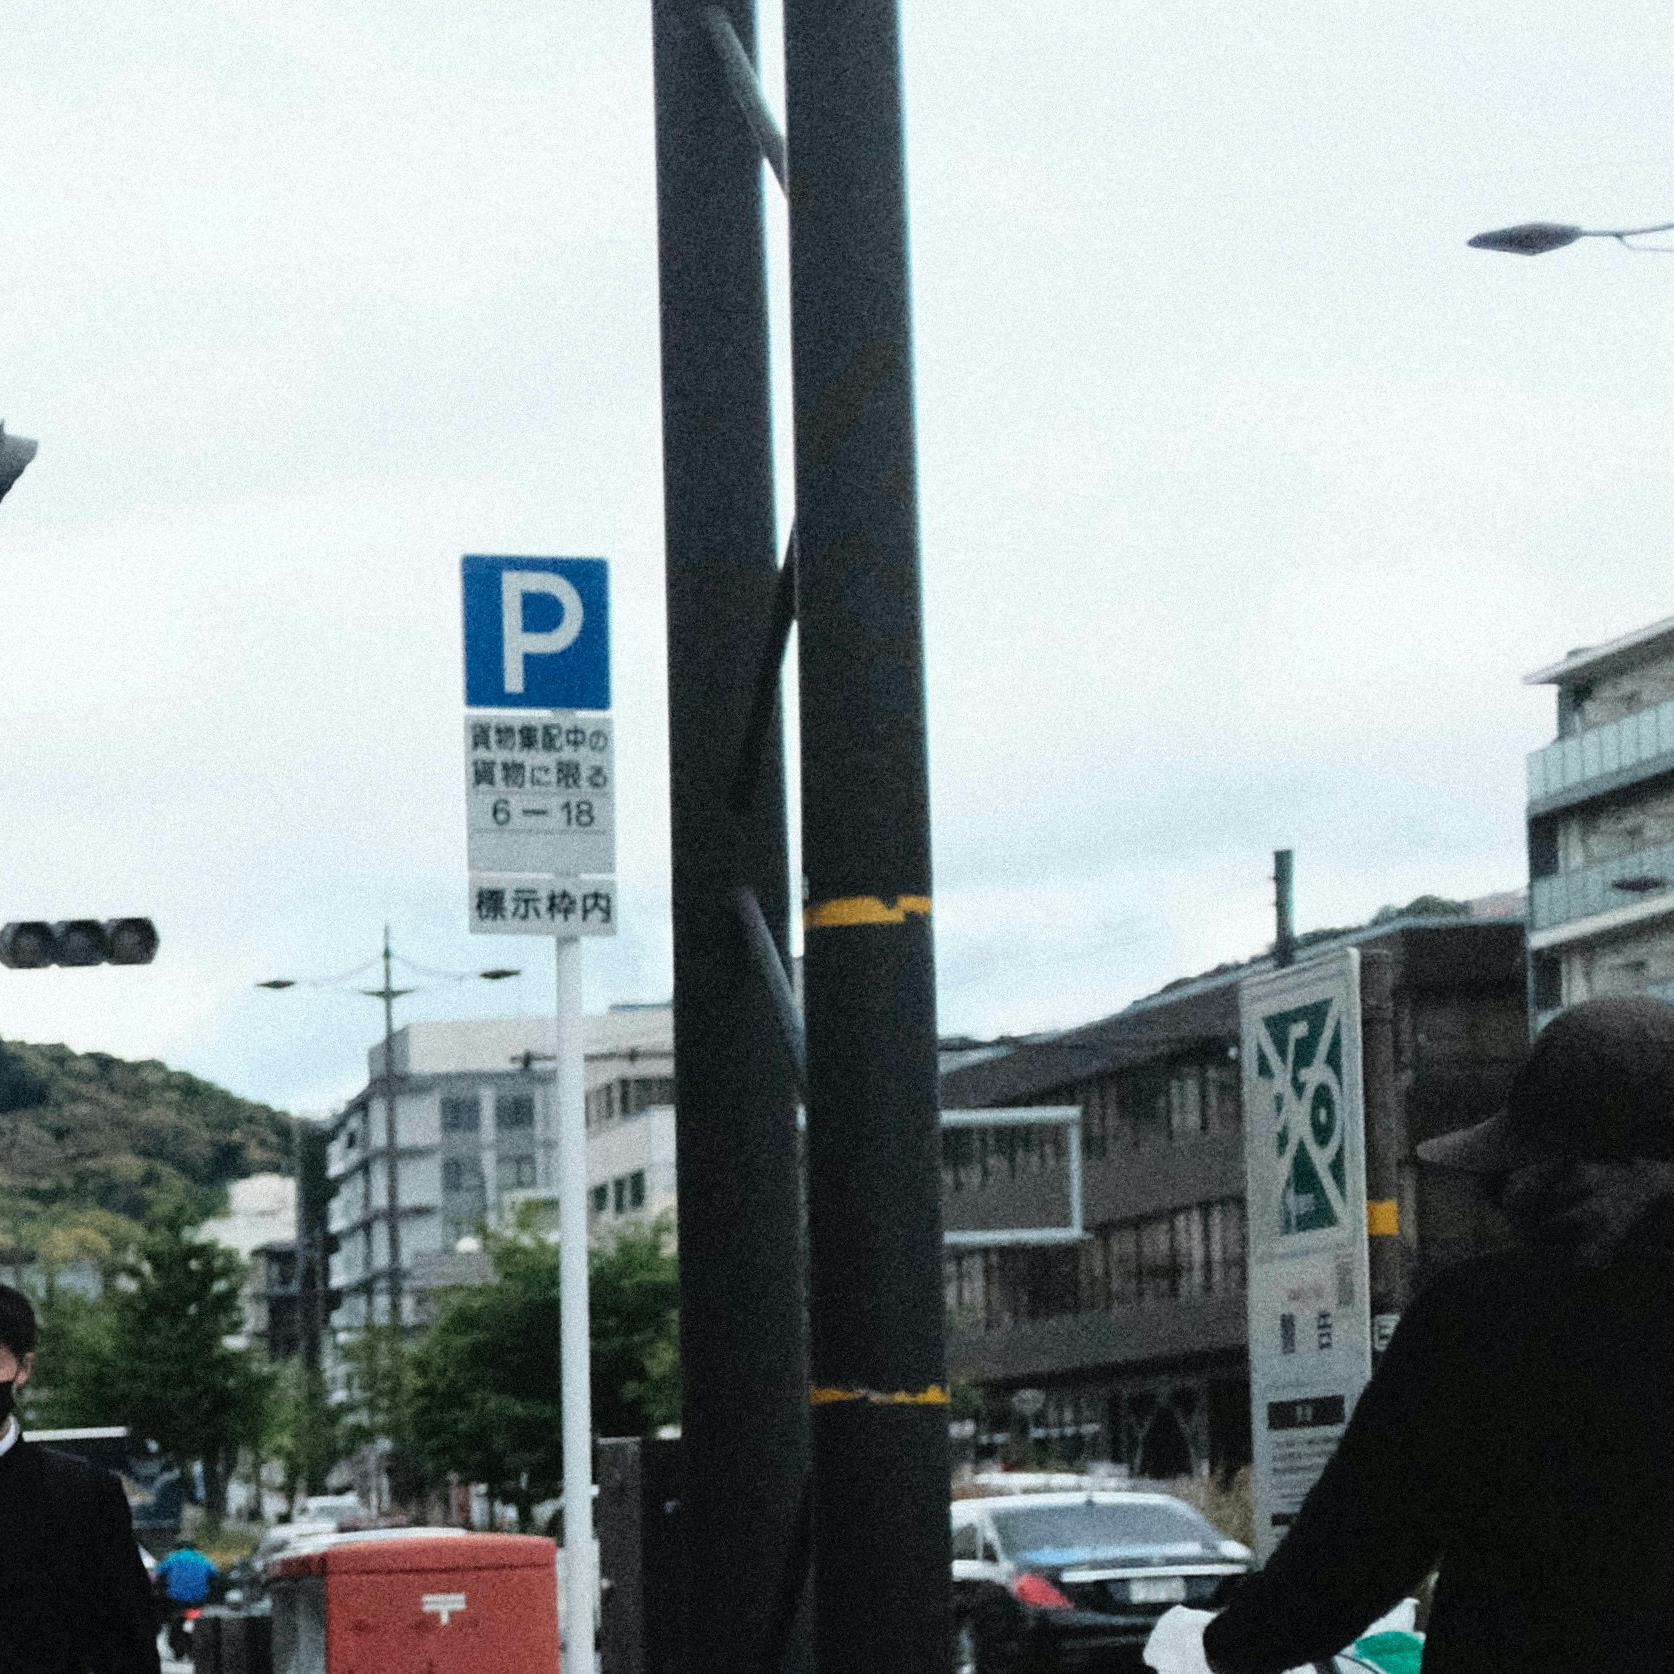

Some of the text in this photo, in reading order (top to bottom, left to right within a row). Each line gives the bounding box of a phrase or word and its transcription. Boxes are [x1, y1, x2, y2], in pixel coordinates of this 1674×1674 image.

[501, 569, 584, 694] P
[470, 723, 609, 752] 貨物集配中の
[475, 887, 612, 923] 標示枠内
